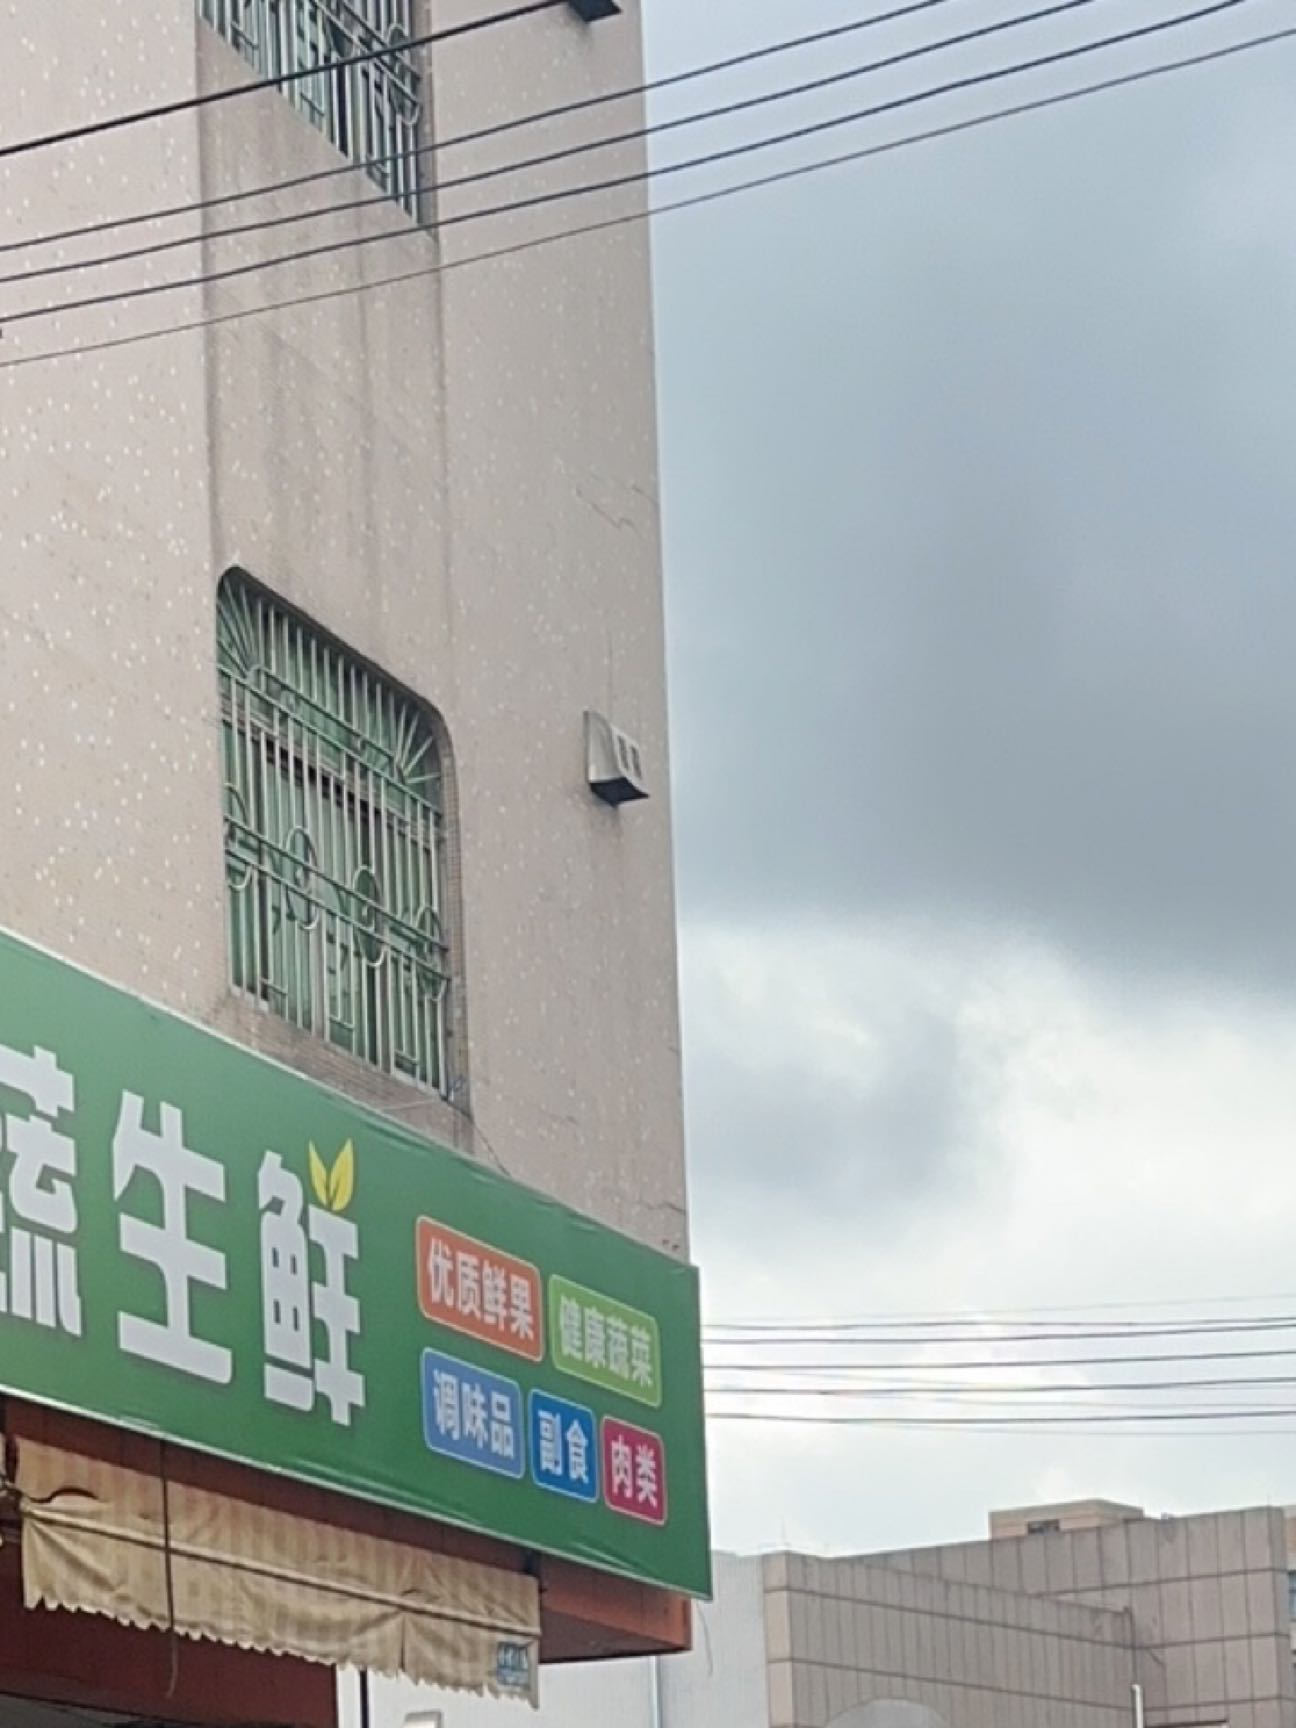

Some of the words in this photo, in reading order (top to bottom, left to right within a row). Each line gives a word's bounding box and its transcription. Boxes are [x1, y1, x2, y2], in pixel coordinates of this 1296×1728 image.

[427, 1238, 534, 1341] 优质鲜果
[559, 1295, 654, 1387] 健康蔬菜
[432, 1368, 515, 1459] 调味品
[539, 1410, 589, 1484] 副食
[610, 1435, 657, 1507] 肉类
